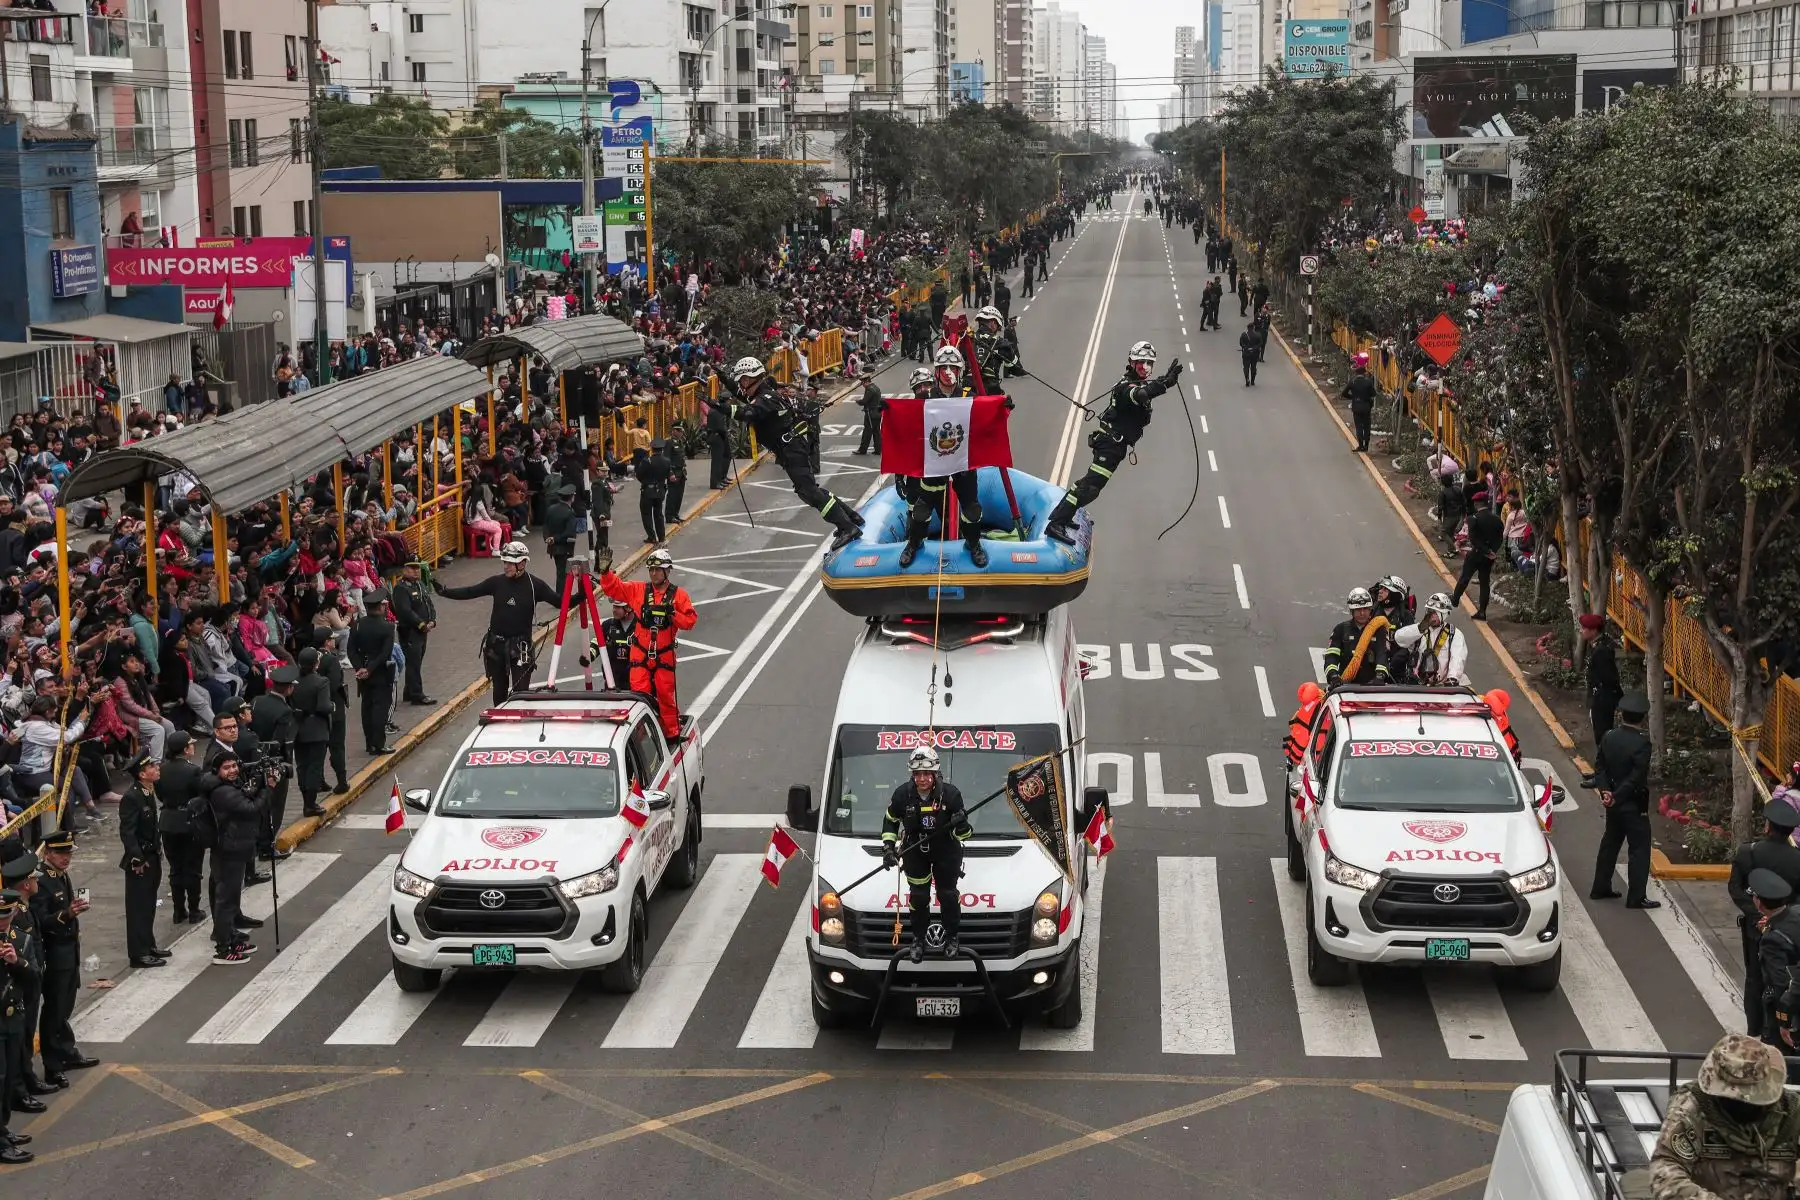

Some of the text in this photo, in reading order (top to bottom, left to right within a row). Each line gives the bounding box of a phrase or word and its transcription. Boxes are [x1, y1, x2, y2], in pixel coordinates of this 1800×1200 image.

[1288, 45, 1347, 57] DISPONIBLE
[1426, 92, 1568, 102] YOU GOT THIS
[610, 136, 644, 144] AMERICA
[612, 128, 643, 136] PETRO
[68, 252, 93, 263] Ortopedia
[140, 256, 259, 275] INFORMES
[64, 264, 97, 278] Pro-Infirmis
[1075, 643, 1221, 681] BUS
[876, 730, 1017, 750] RESCATE
[466, 750, 611, 766] RESCATE
[1350, 741, 1499, 759] RESCATE
[1086, 752, 1269, 807] OLO
[1014, 797, 1030, 817] AUXILIO
